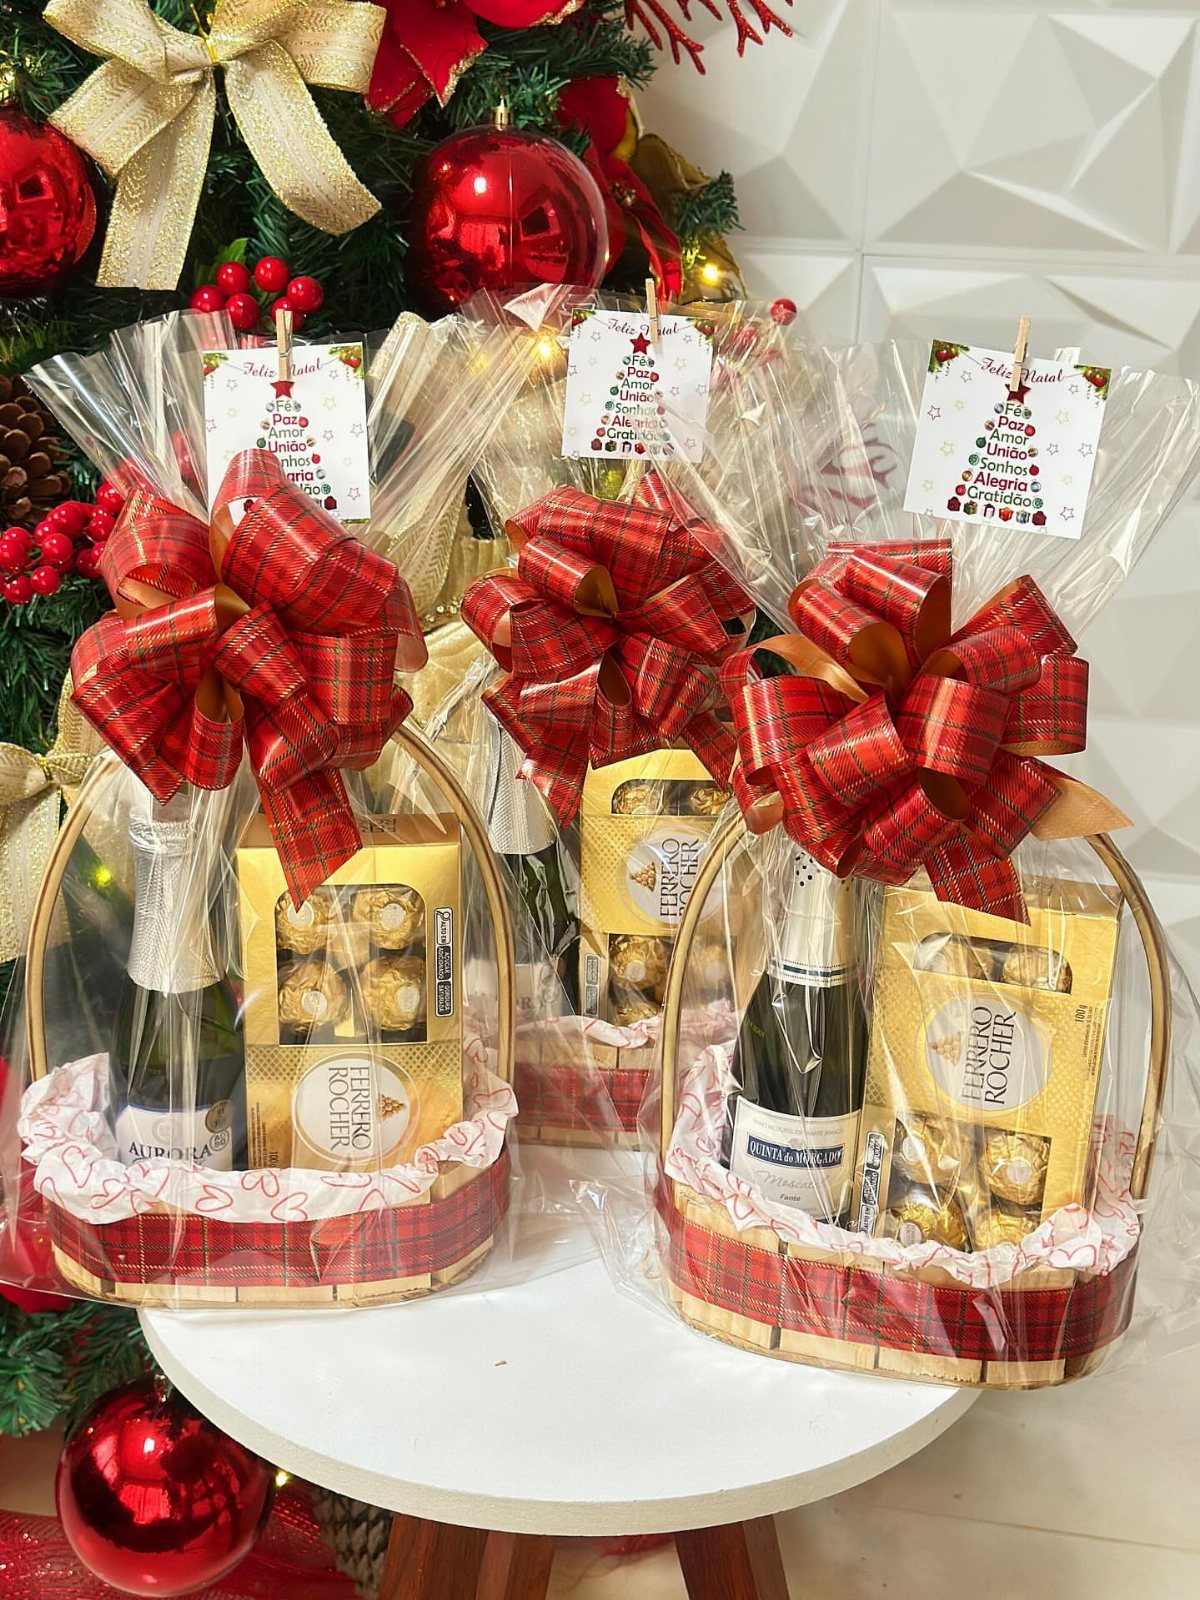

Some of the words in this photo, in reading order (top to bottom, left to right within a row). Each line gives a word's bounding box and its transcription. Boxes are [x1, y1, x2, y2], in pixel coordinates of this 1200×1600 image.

[608, 318, 636, 335] Feliz
[632, 354, 647, 366] Fé
[243, 361, 276, 378] Feliz
[627, 367, 650, 378] Paz
[981, 357, 1013, 379] Feliz
[1021, 367, 1064, 383] Natal
[621, 378, 654, 390] Amor
[620, 390, 654, 402] União
[276, 400, 292, 412] Fé
[1004, 403, 1022, 417] Fé
[272, 413, 298, 426] Paz
[997, 416, 1024, 432] Paz
[268, 426, 305, 439] Amor
[989, 428, 1030, 446] Amor
[268, 440, 307, 453] União
[986, 443, 1028, 460] União
[281, 454, 311, 468] nhos
[979, 457, 1028, 476] Sonhos
[973, 472, 1028, 492] Alegria
[967, 485, 1032, 508] Gratidão
[660, 838, 680, 917] FERRERO
[961, 1006, 993, 1101] FERRERO
[984, 1010, 1017, 1105] ROCHER
[328, 1067, 350, 1150] ROCHER
[350, 1066, 372, 1150] FERRERO
[129, 1141, 213, 1161] AURORA
[749, 1140, 783, 1161] QUINTA
[784, 1152, 794, 1164] do
[794, 1149, 842, 1165] MORGADO
